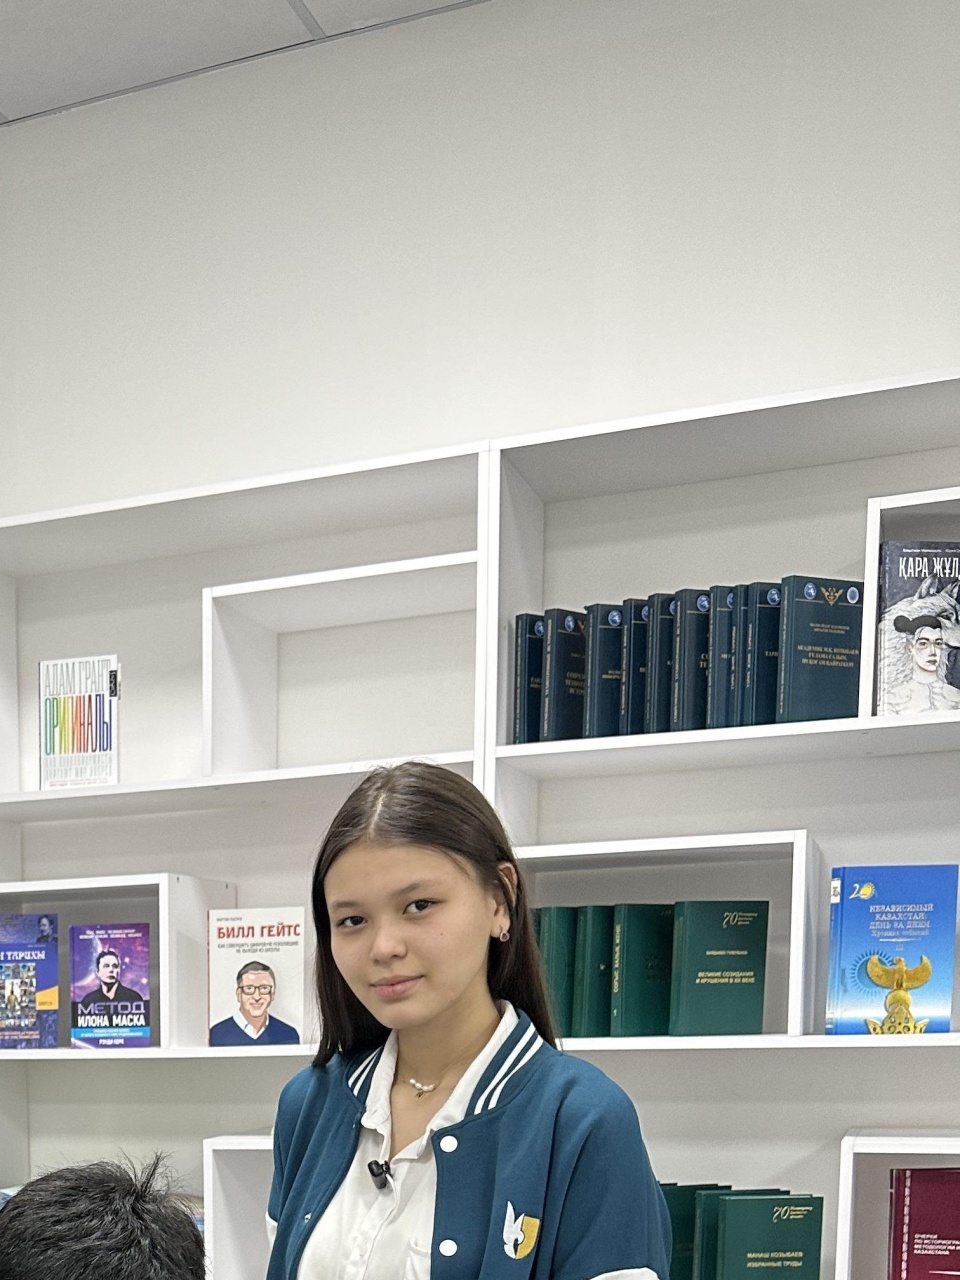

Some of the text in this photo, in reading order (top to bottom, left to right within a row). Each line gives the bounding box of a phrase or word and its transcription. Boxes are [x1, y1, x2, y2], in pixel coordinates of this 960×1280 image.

[898, 556, 960, 580] ҚАРА ЖҰЛ
[44, 662, 76, 697] АДАМ
[44, 693, 112, 756] ОРИГИНАЛЫ
[869, 902, 934, 912] НЕЗАВИСИМЫЙ
[722, 912, 739, 928] 70
[869, 922, 891, 930] ДЕНЬ
[217, 922, 301, 940] БИЛЛ ГЕЙТС
[871, 930, 899, 938] Хроника
[78, 1001, 146, 1015] МЕТОД
[78, 1014, 146, 1028] ИЛОНА МАСКА
[772, 1206, 790, 1223] 70
